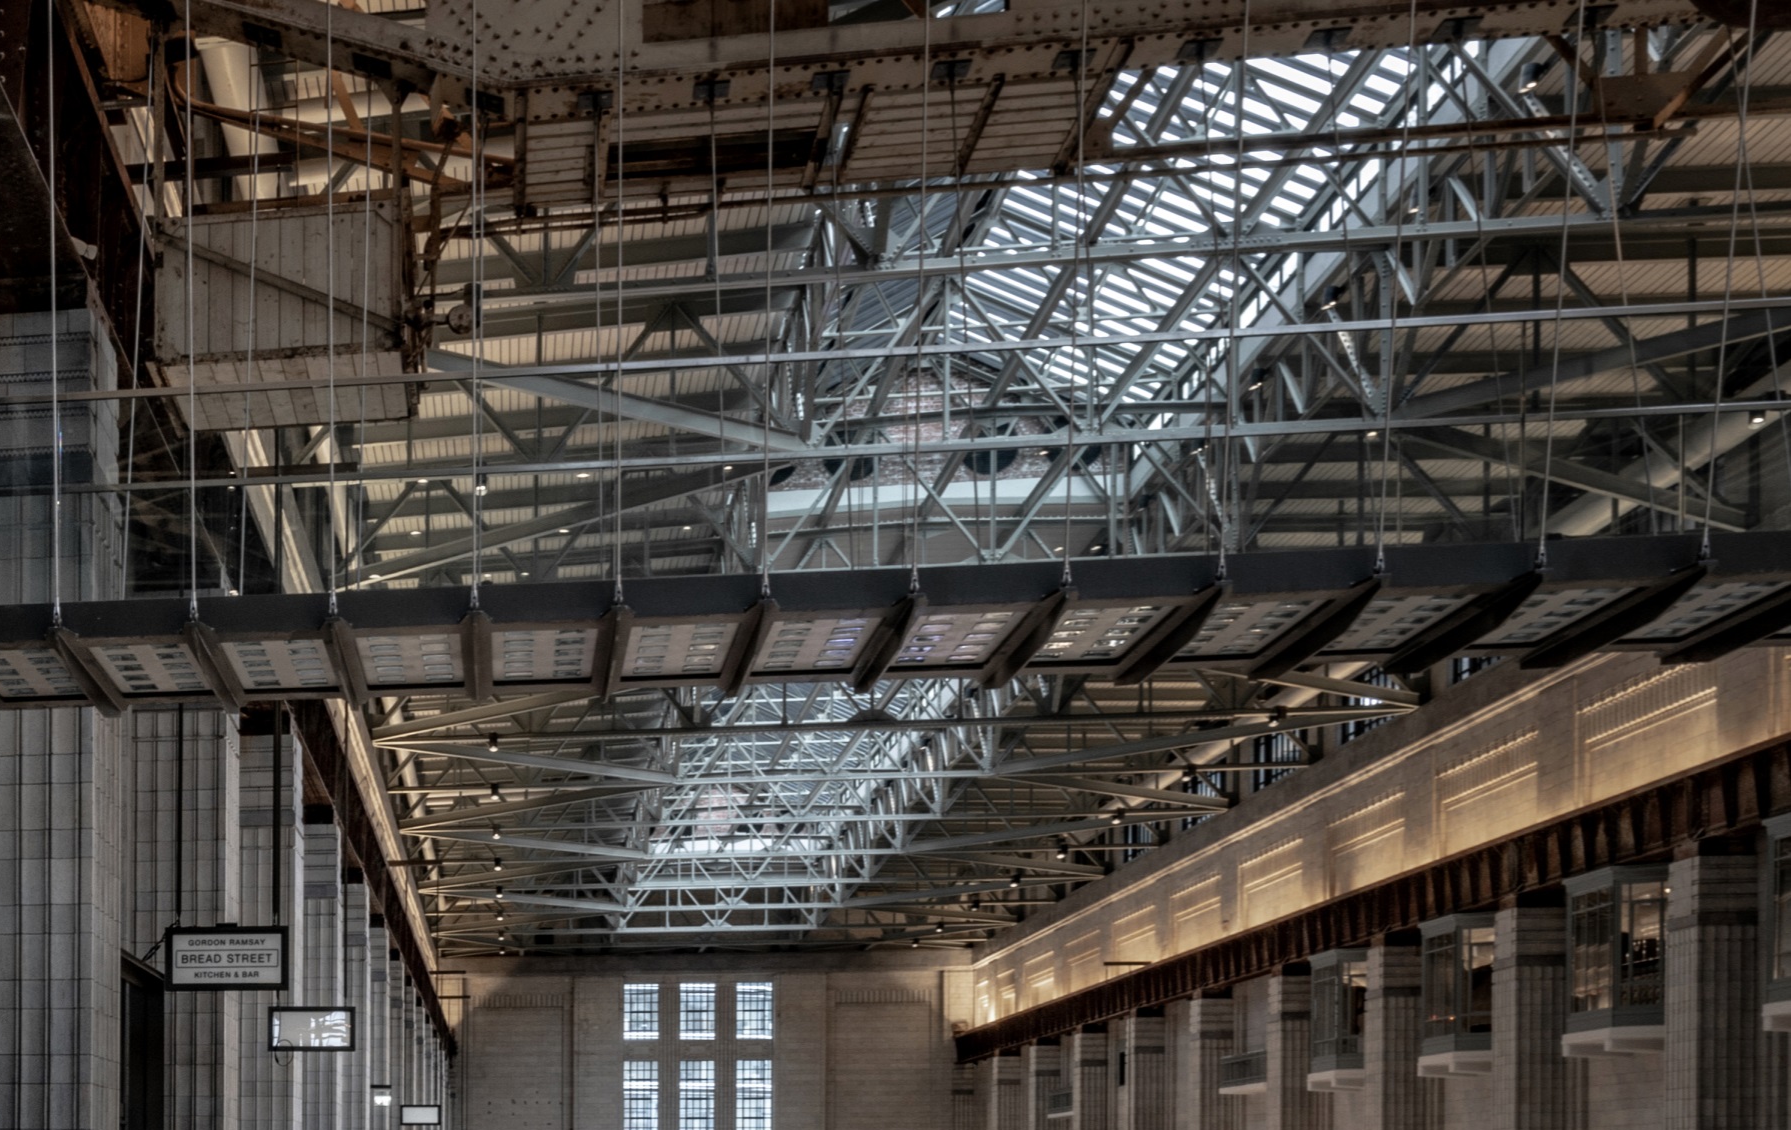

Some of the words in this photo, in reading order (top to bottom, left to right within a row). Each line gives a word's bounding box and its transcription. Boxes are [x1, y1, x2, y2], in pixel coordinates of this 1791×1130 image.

[229, 938, 266, 946] RAMSAY
[181, 953, 222, 964] BREAD
[227, 953, 273, 963] STREET
